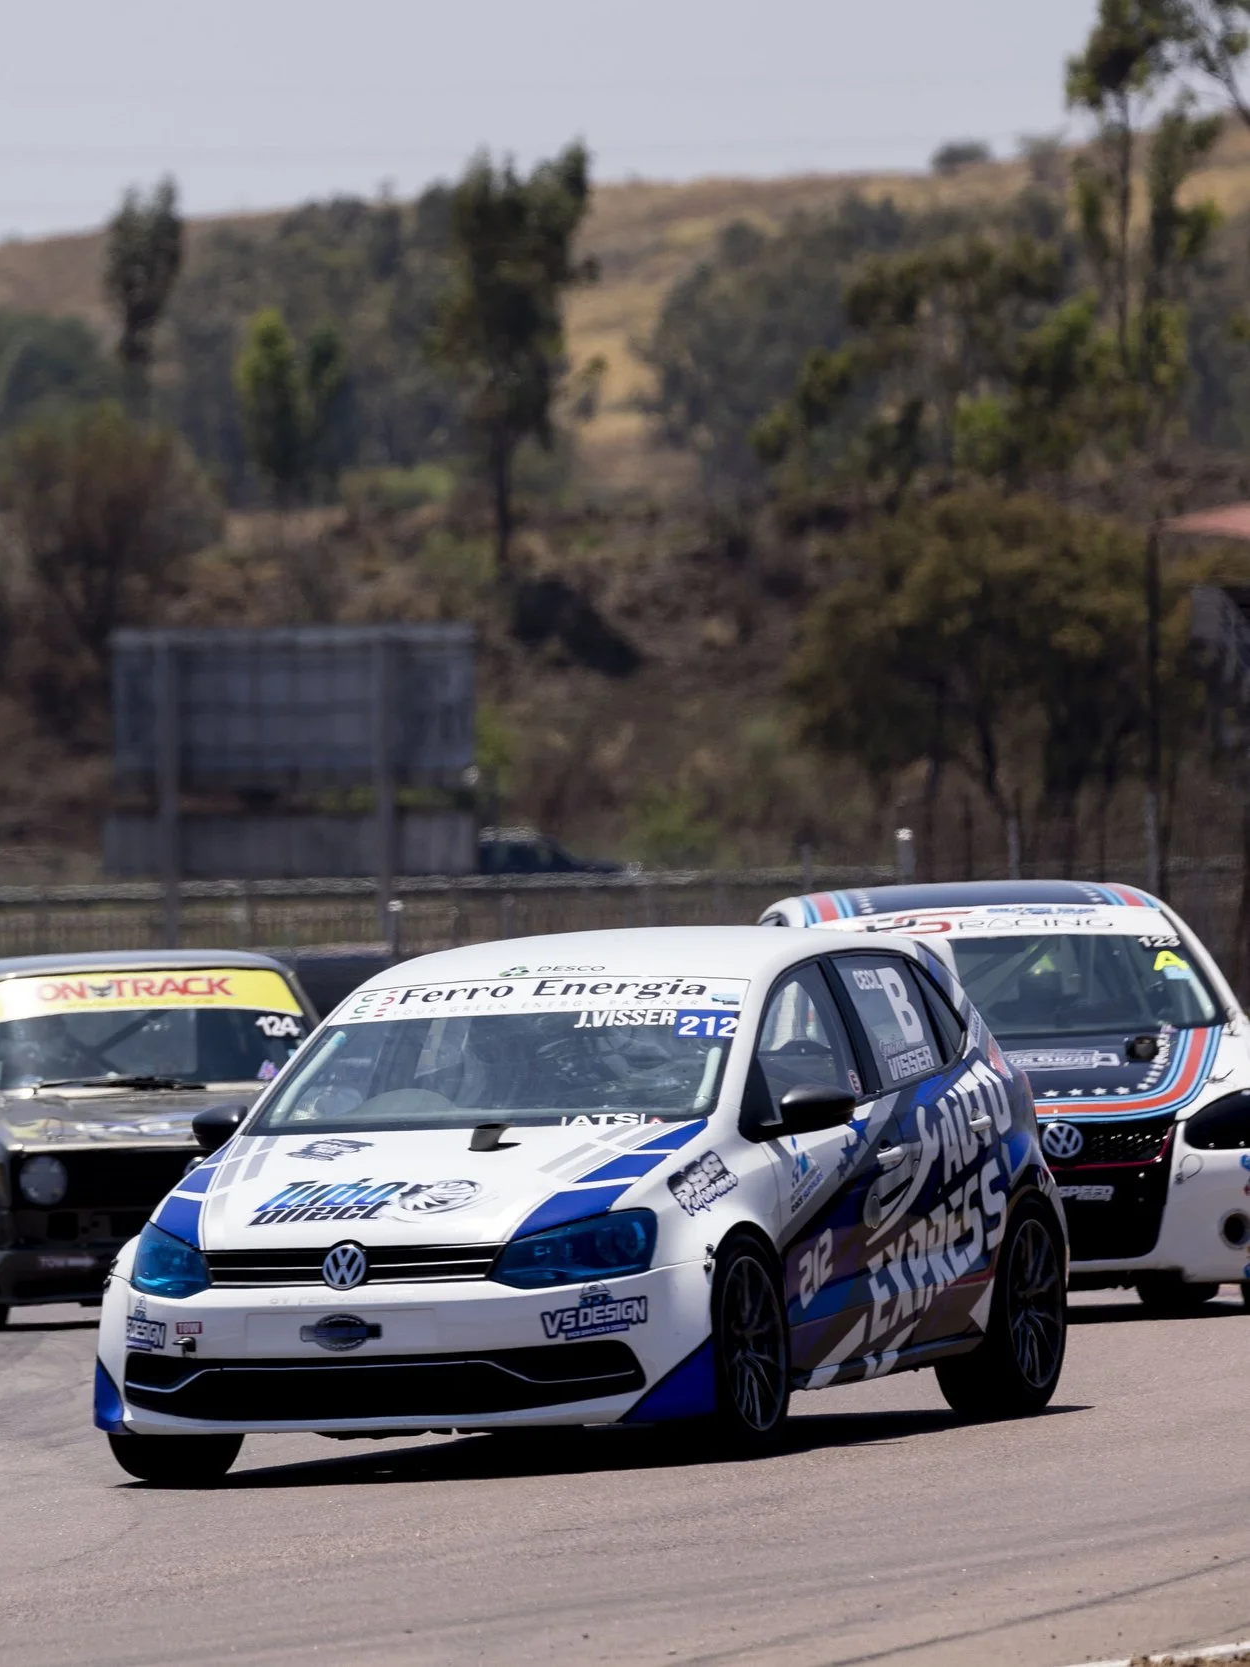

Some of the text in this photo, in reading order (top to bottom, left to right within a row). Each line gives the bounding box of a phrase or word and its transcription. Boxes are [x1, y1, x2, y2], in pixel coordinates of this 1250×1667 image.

[958, 917, 1114, 931] RACING
[1138, 935, 1181, 949] 123
[537, 965, 606, 973] DESCO
[38, 976, 234, 1001] ON TRACK
[399, 978, 707, 1005] Ferro Energia
[393, 998, 699, 1016] YOUR GREEN ENERGY PARTNER
[875, 966, 924, 1044] B
[255, 1015, 301, 1038] 124
[573, 1009, 678, 1029] J.VISSER
[677, 1015, 739, 1037] 212
[888, 1045, 935, 1081] VISSER
[936, 1060, 1012, 1184] AUTO
[866, 1157, 1007, 1345] EXPRESS
[799, 1228, 834, 1310] 212
[178, 1322, 201, 1334] TOW
